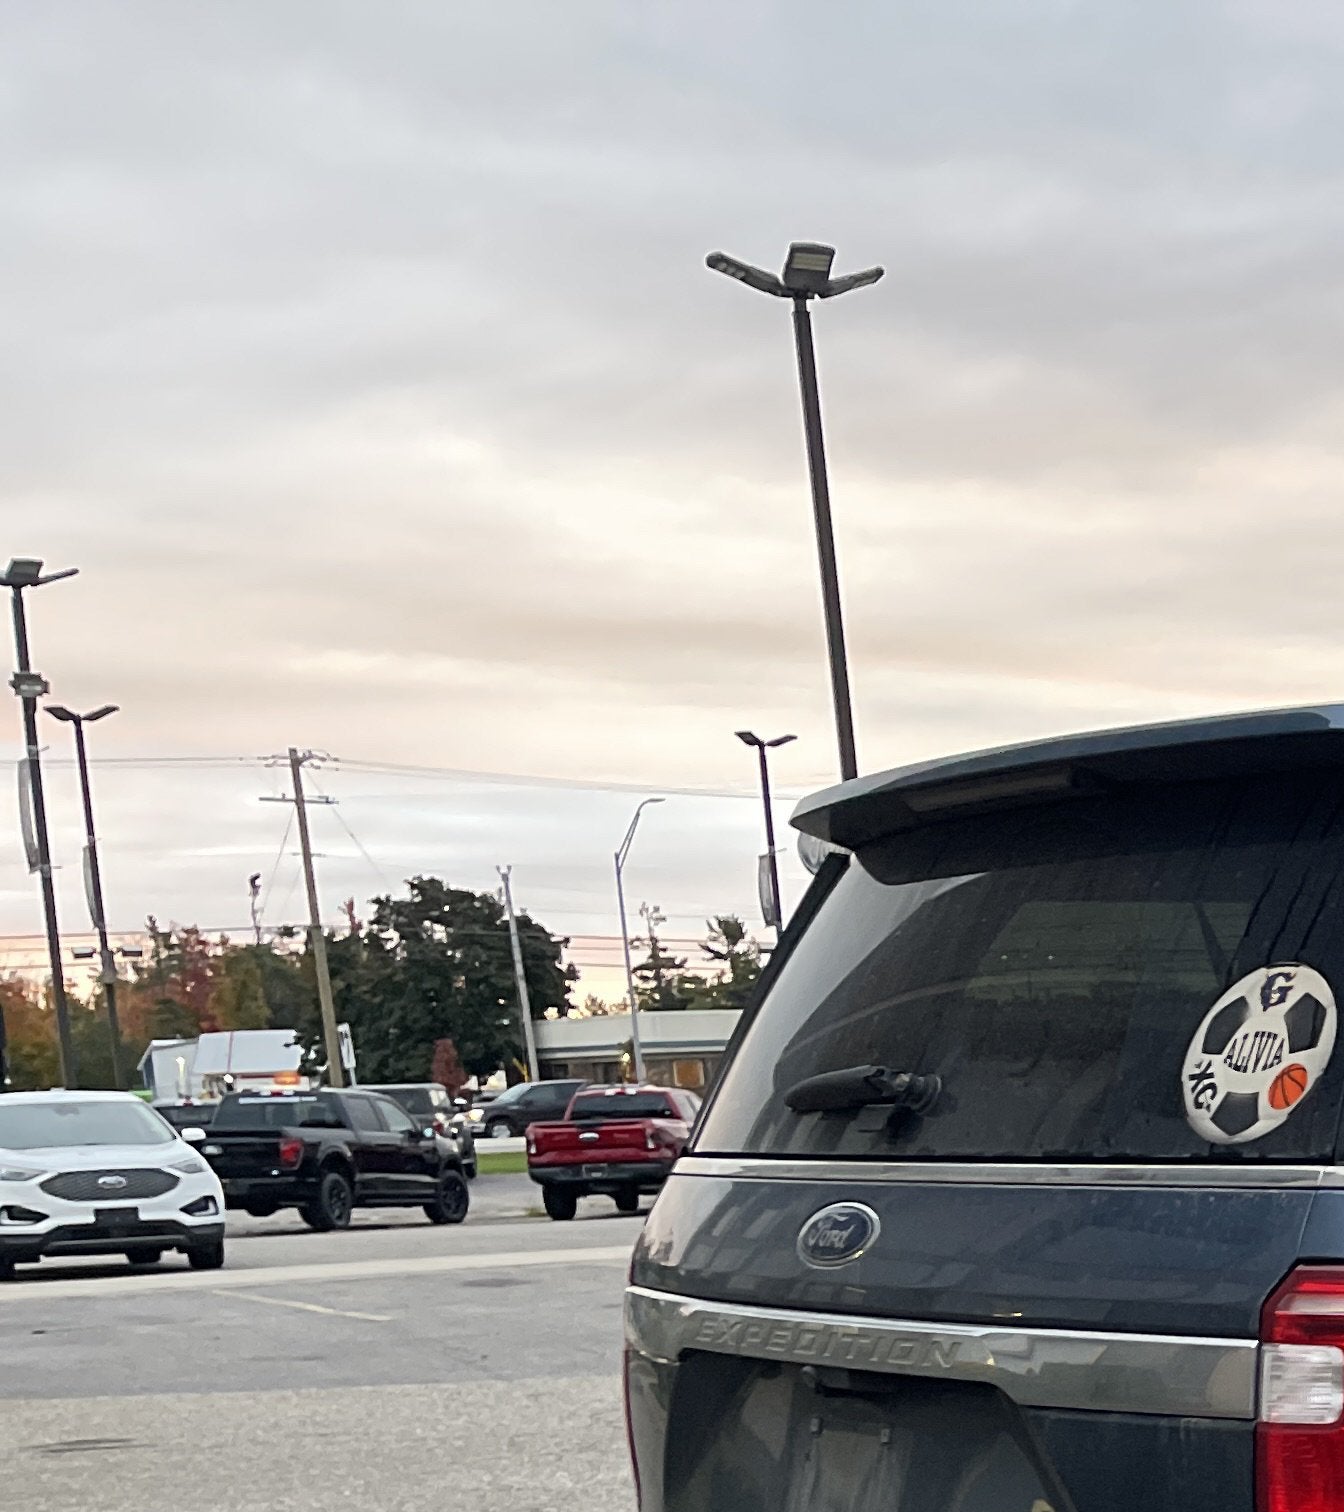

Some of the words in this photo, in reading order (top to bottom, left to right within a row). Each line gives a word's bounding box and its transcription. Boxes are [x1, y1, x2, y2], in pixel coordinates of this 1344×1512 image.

[1260, 971, 1297, 1012] G
[1223, 1030, 1286, 1074] ALIVIA
[696, 1316, 962, 1368] EXPEDITION
